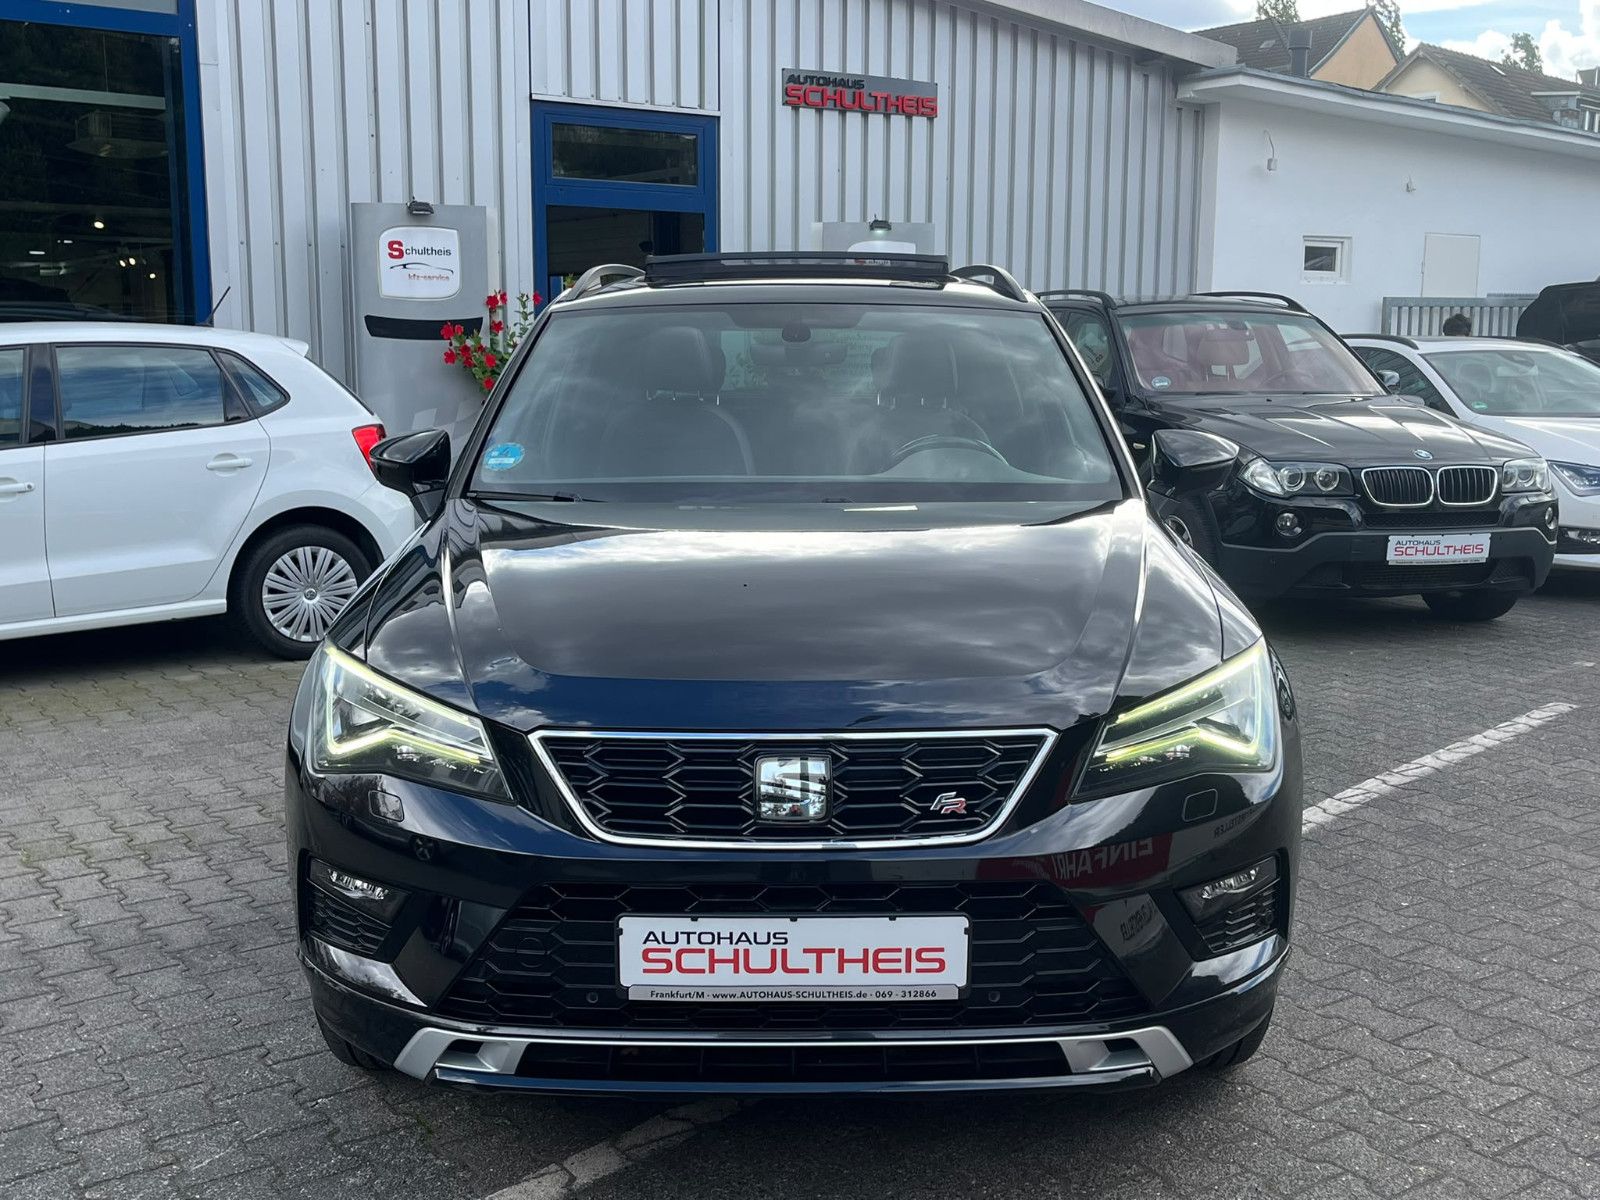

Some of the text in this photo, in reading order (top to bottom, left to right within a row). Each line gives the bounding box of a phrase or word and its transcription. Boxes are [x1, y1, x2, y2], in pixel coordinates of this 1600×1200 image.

[786, 74, 865, 90] AUTOHAUS
[785, 84, 938, 117] SCHULTHEIS
[387, 240, 452, 260] Schultheis
[1394, 543, 1485, 557] SCHULTHEIS
[642, 930, 789, 946] AUTOHAUS
[641, 946, 946, 975] SCHULTHEIS
[650, 988, 937, 999] Frankfurt/M www.AUTOHAUS-SCHULTHEIS.de 069 312866
